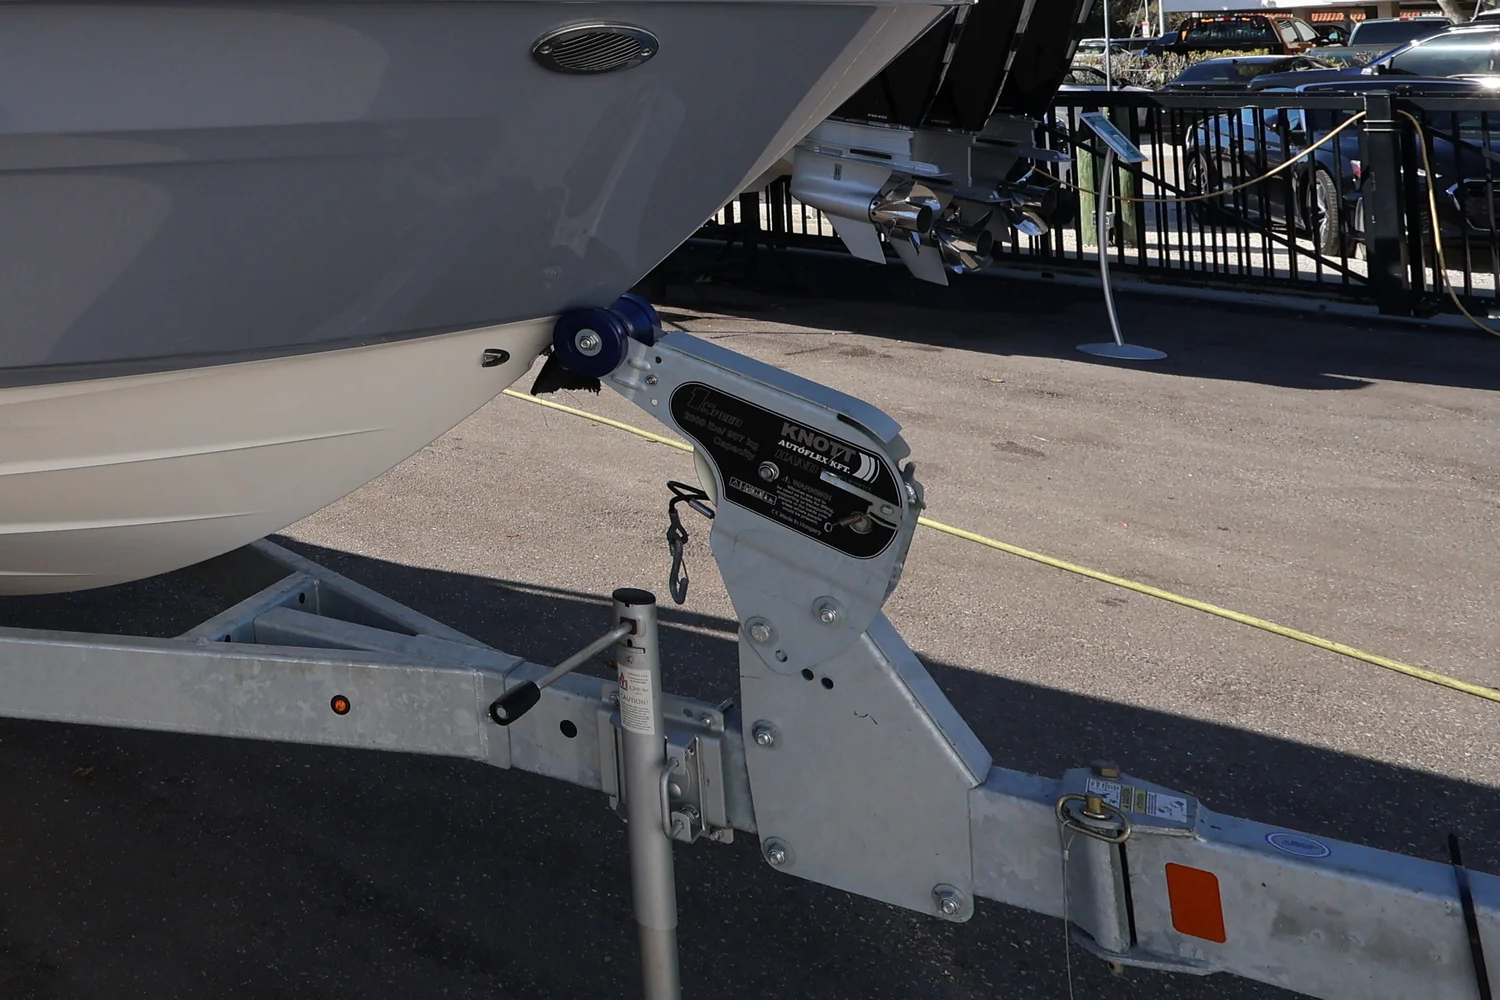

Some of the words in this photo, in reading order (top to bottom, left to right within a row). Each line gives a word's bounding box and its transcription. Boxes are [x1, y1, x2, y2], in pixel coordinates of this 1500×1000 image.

[777, 439, 830, 465] AUTÓFLEX
[829, 460, 851, 475] KFT.
[781, 422, 857, 463] KNOTT
